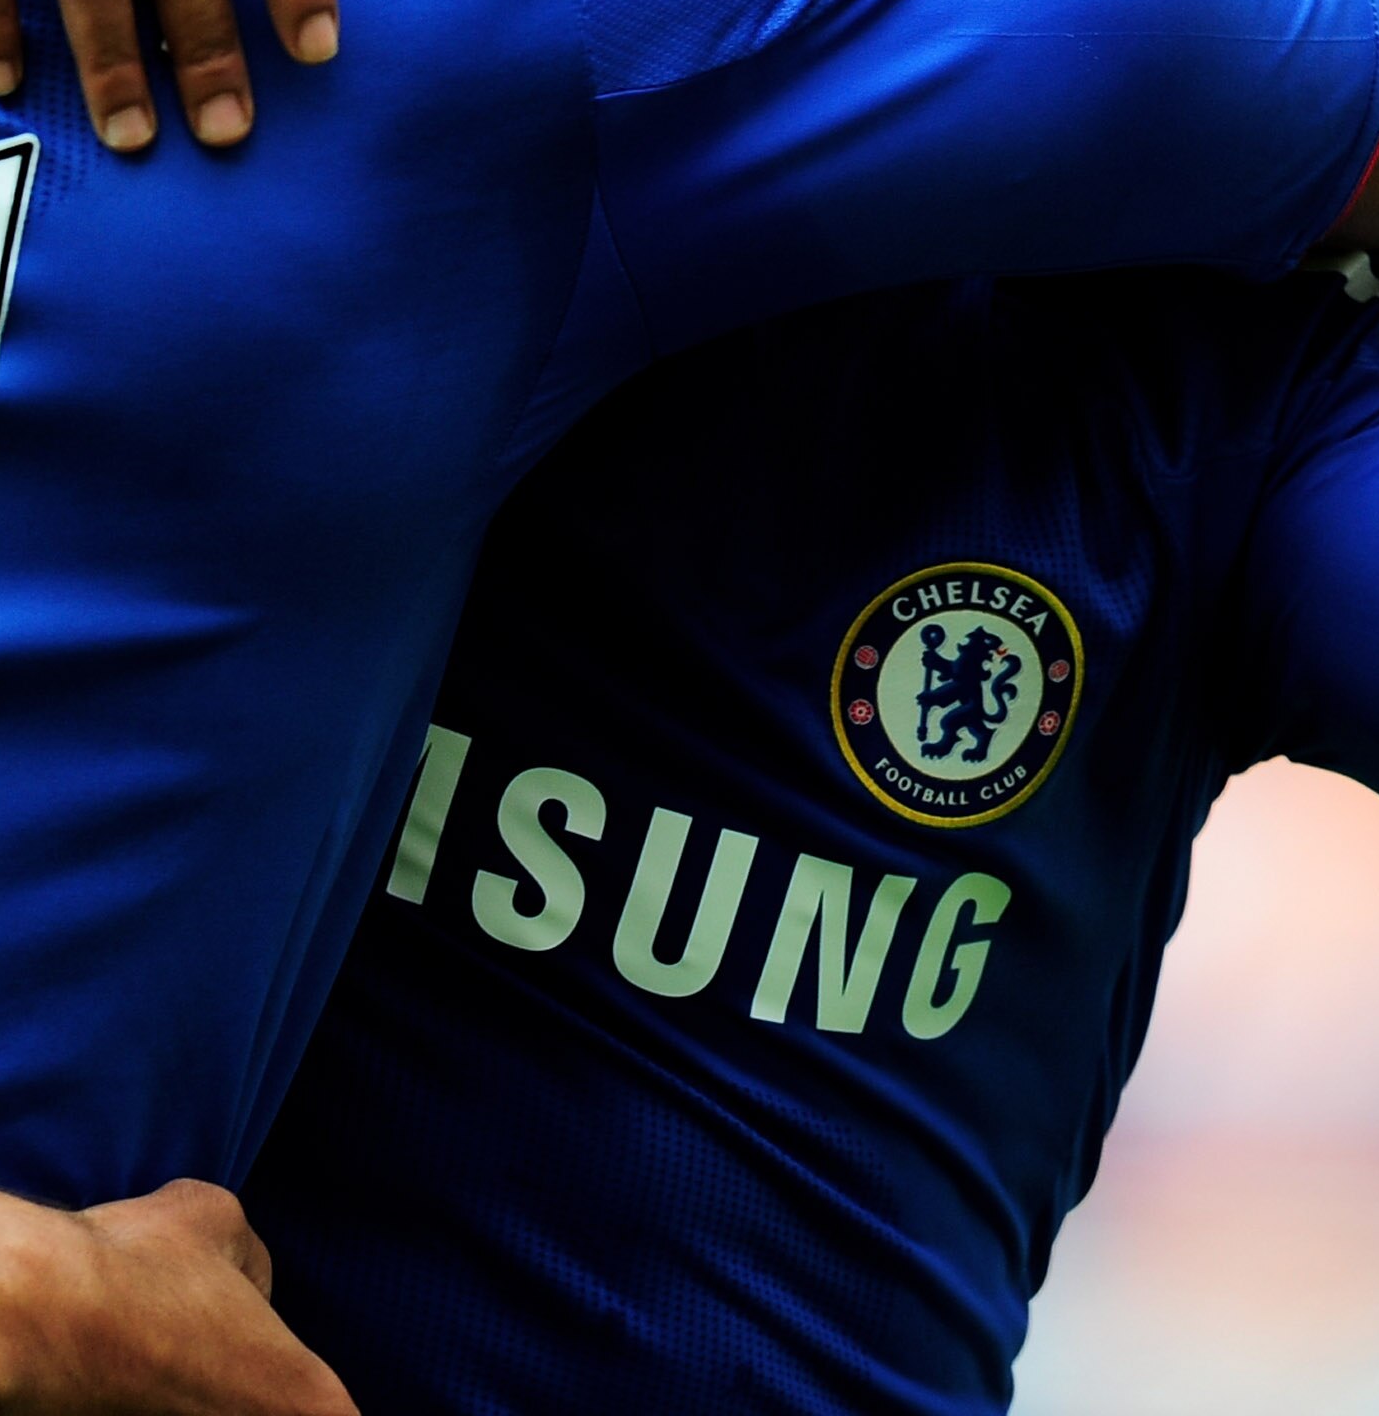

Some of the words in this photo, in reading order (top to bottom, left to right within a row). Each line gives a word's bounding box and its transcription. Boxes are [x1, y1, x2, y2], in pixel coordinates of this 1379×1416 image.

[892, 581, 1049, 636] CHELSEA
[875, 758, 969, 805] FOOTBALL
[980, 765, 1027, 800] CLUB
